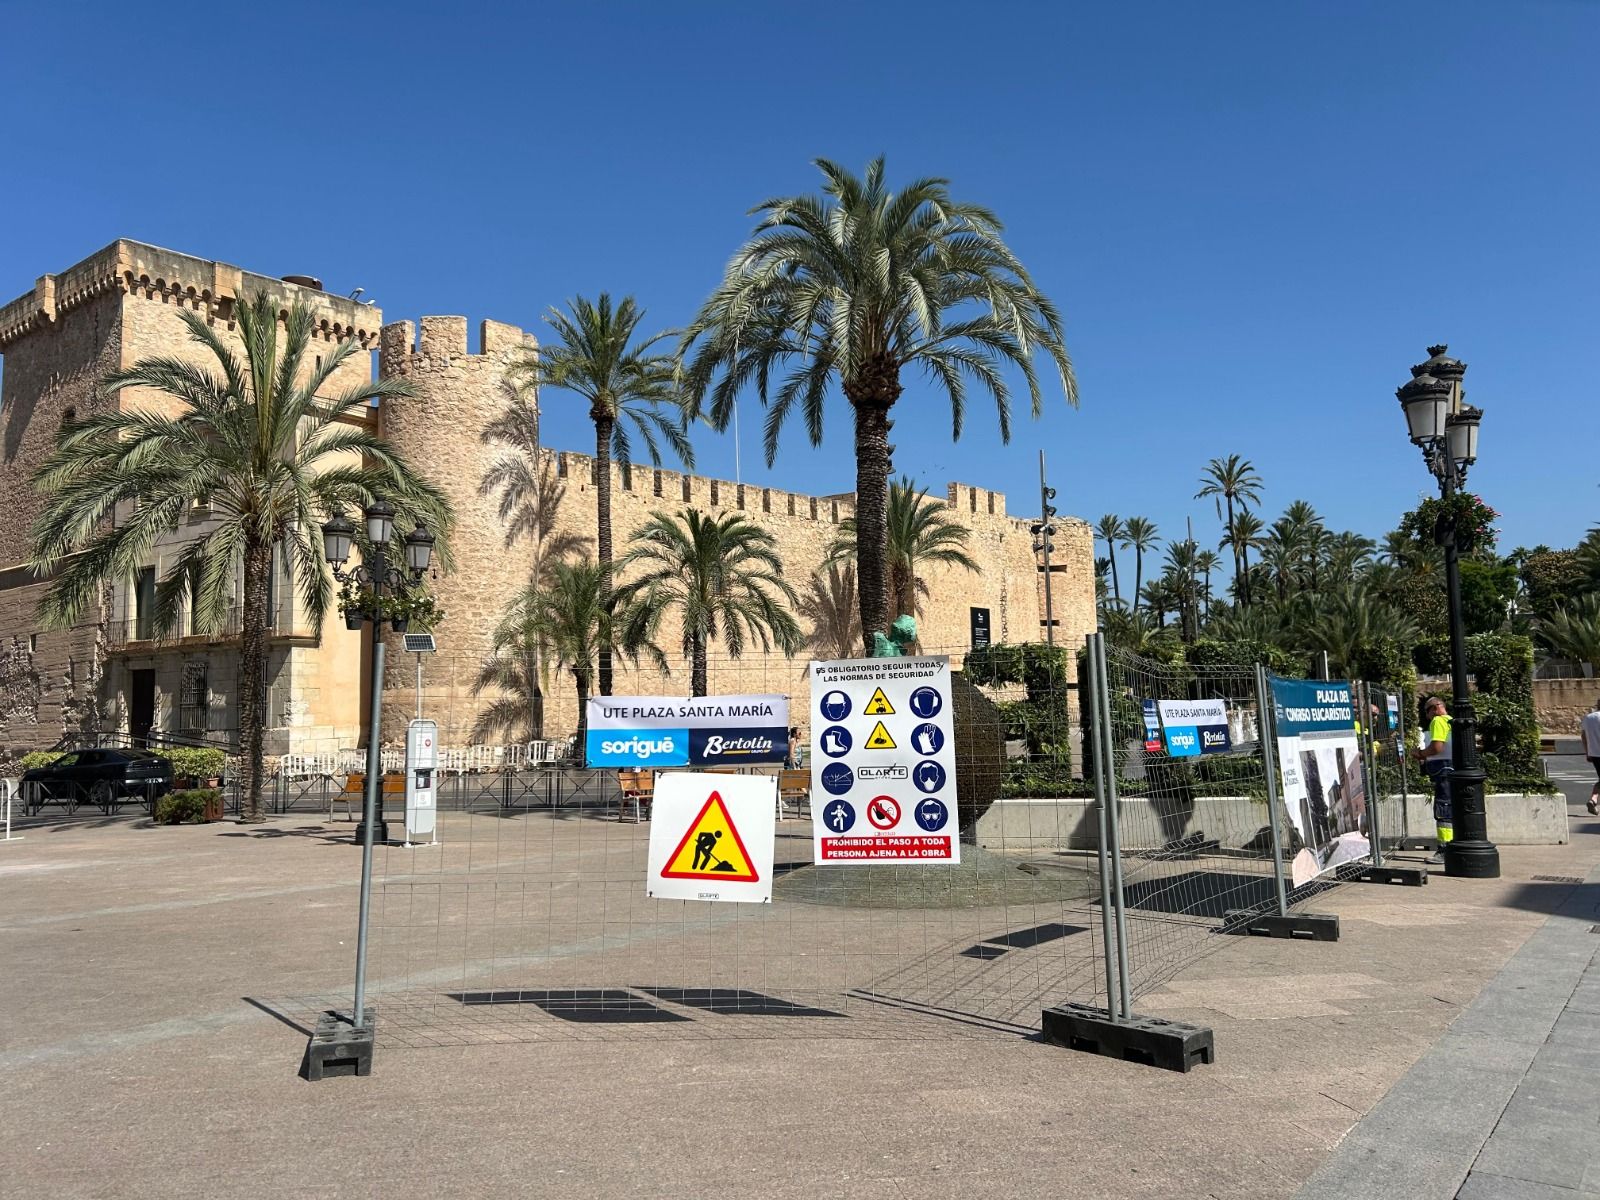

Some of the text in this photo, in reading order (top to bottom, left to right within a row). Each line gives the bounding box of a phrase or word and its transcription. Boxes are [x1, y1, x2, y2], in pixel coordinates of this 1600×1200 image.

[828, 664, 880, 674] OBLIGATORIO
[882, 662, 912, 671] SEGUIR
[914, 661, 941, 669] TODAS
[840, 673, 874, 682] NORMAS
[888, 670, 934, 679] SEGURIDAD
[1316, 690, 1350, 703] PLAZA DEL
[603, 702, 773, 719] UTE PLAZA SANTA MARÍA
[1165, 708, 1176, 718] UTE
[1175, 708, 1190, 718] PLAZA
[1190, 708, 1206, 718] SANTA
[1311, 704, 1351, 721] EUCARÍSTICO
[827, 839, 874, 847] PROHIBIDO
[827, 850, 868, 858] PERSONA
